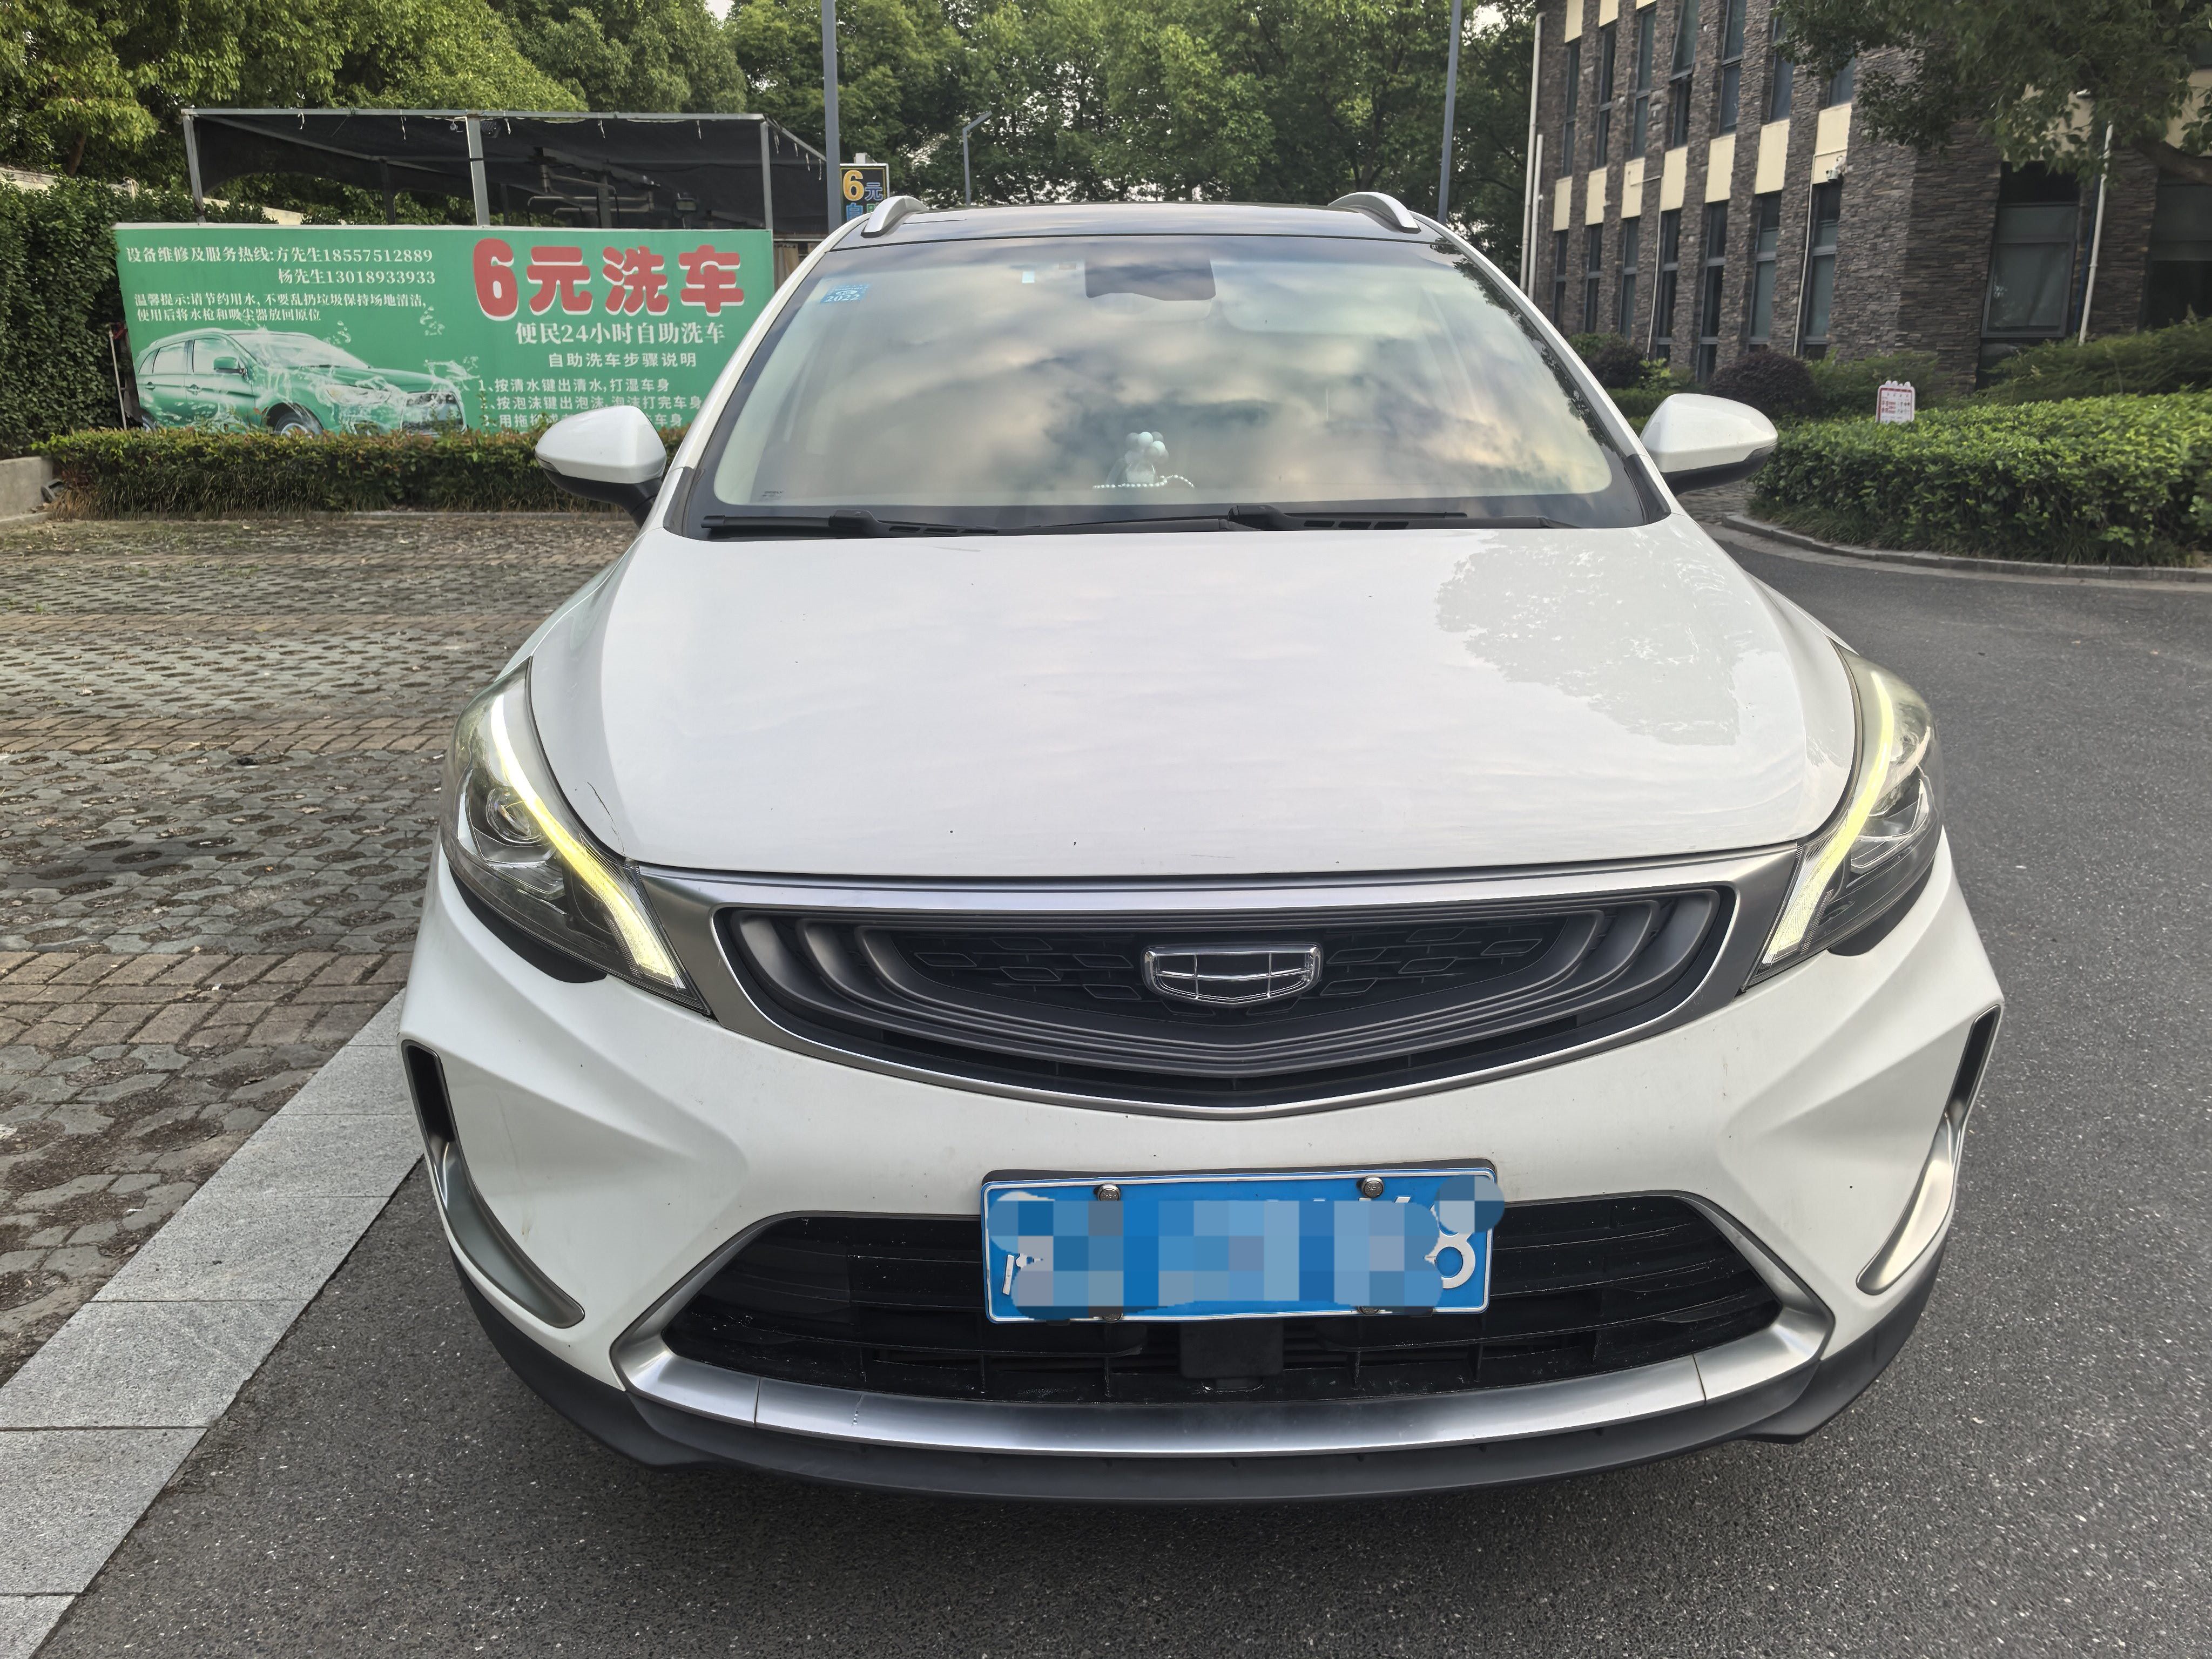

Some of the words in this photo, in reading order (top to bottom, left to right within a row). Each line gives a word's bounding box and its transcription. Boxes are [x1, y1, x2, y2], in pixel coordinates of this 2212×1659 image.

[843, 170, 883, 201] 6元
[278, 268, 435, 284] 杨先生13018933933
[473, 238, 744, 321] 6元洗车
[824, 294, 860, 303] 2022
[137, 308, 321, 322] 使用后将水枪和吸尘器放回原位
[516, 322, 725, 345] 便民24小时自助洗车
[549, 353, 697, 368] 自助洗车步骤说明
